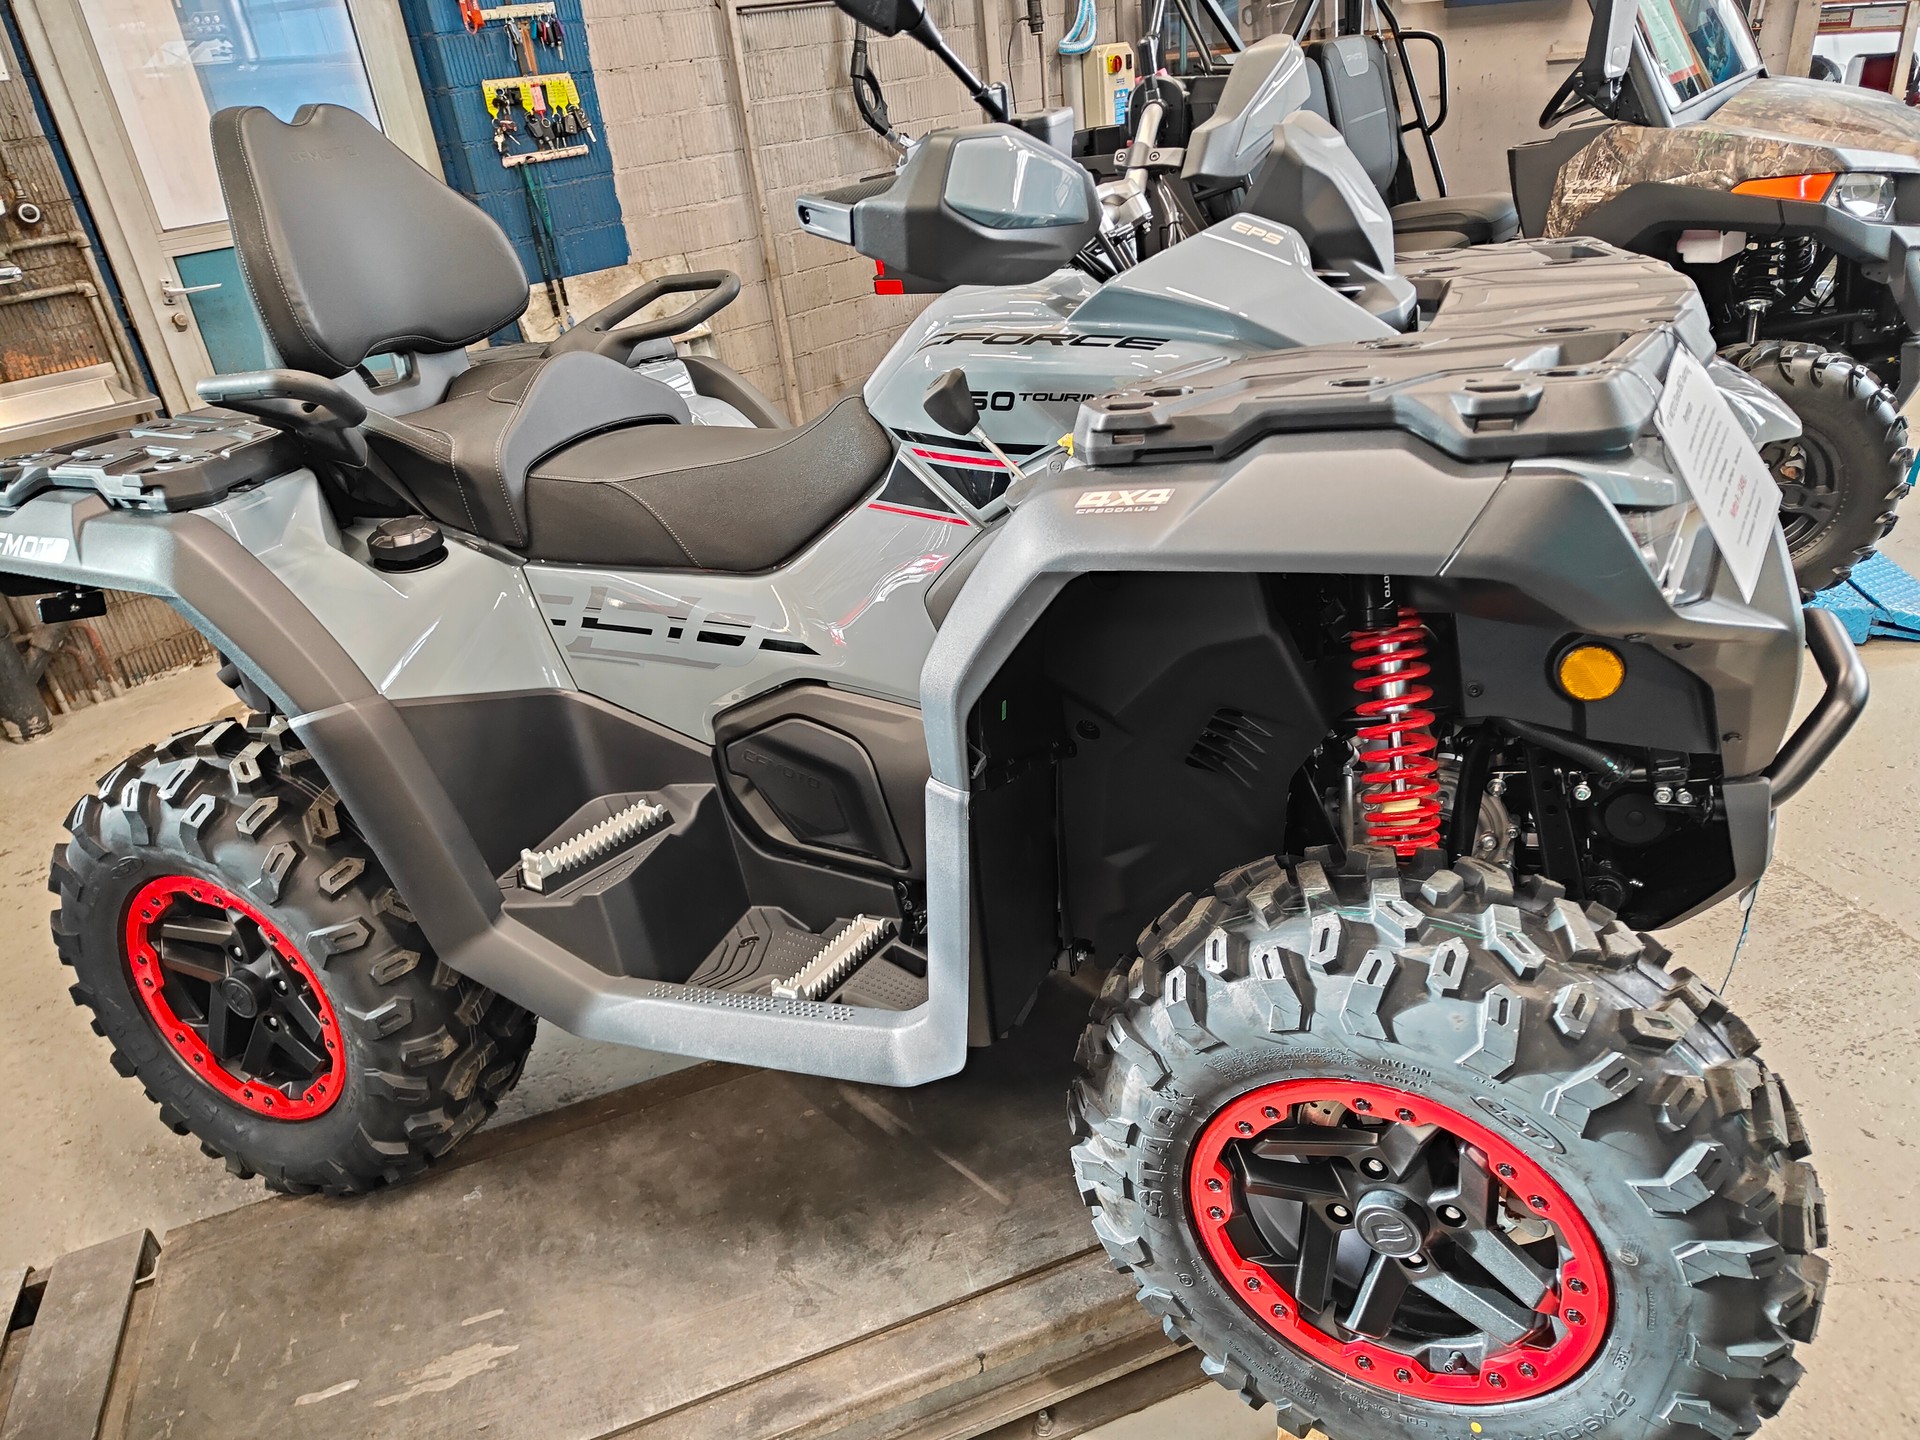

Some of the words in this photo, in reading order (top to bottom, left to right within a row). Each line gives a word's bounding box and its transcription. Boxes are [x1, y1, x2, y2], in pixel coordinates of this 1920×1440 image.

[1561, 191, 1606, 206] EPS
[1231, 221, 1285, 245] EPS
[915, 332, 1171, 355] CFORCE
[969, 391, 1015, 411] 50
[1018, 392, 1098, 403] TOURIN
[1074, 488, 1176, 509] 4X4
[1383, 574, 1391, 598] OTO
[1476, 1096, 1549, 1139] CST
